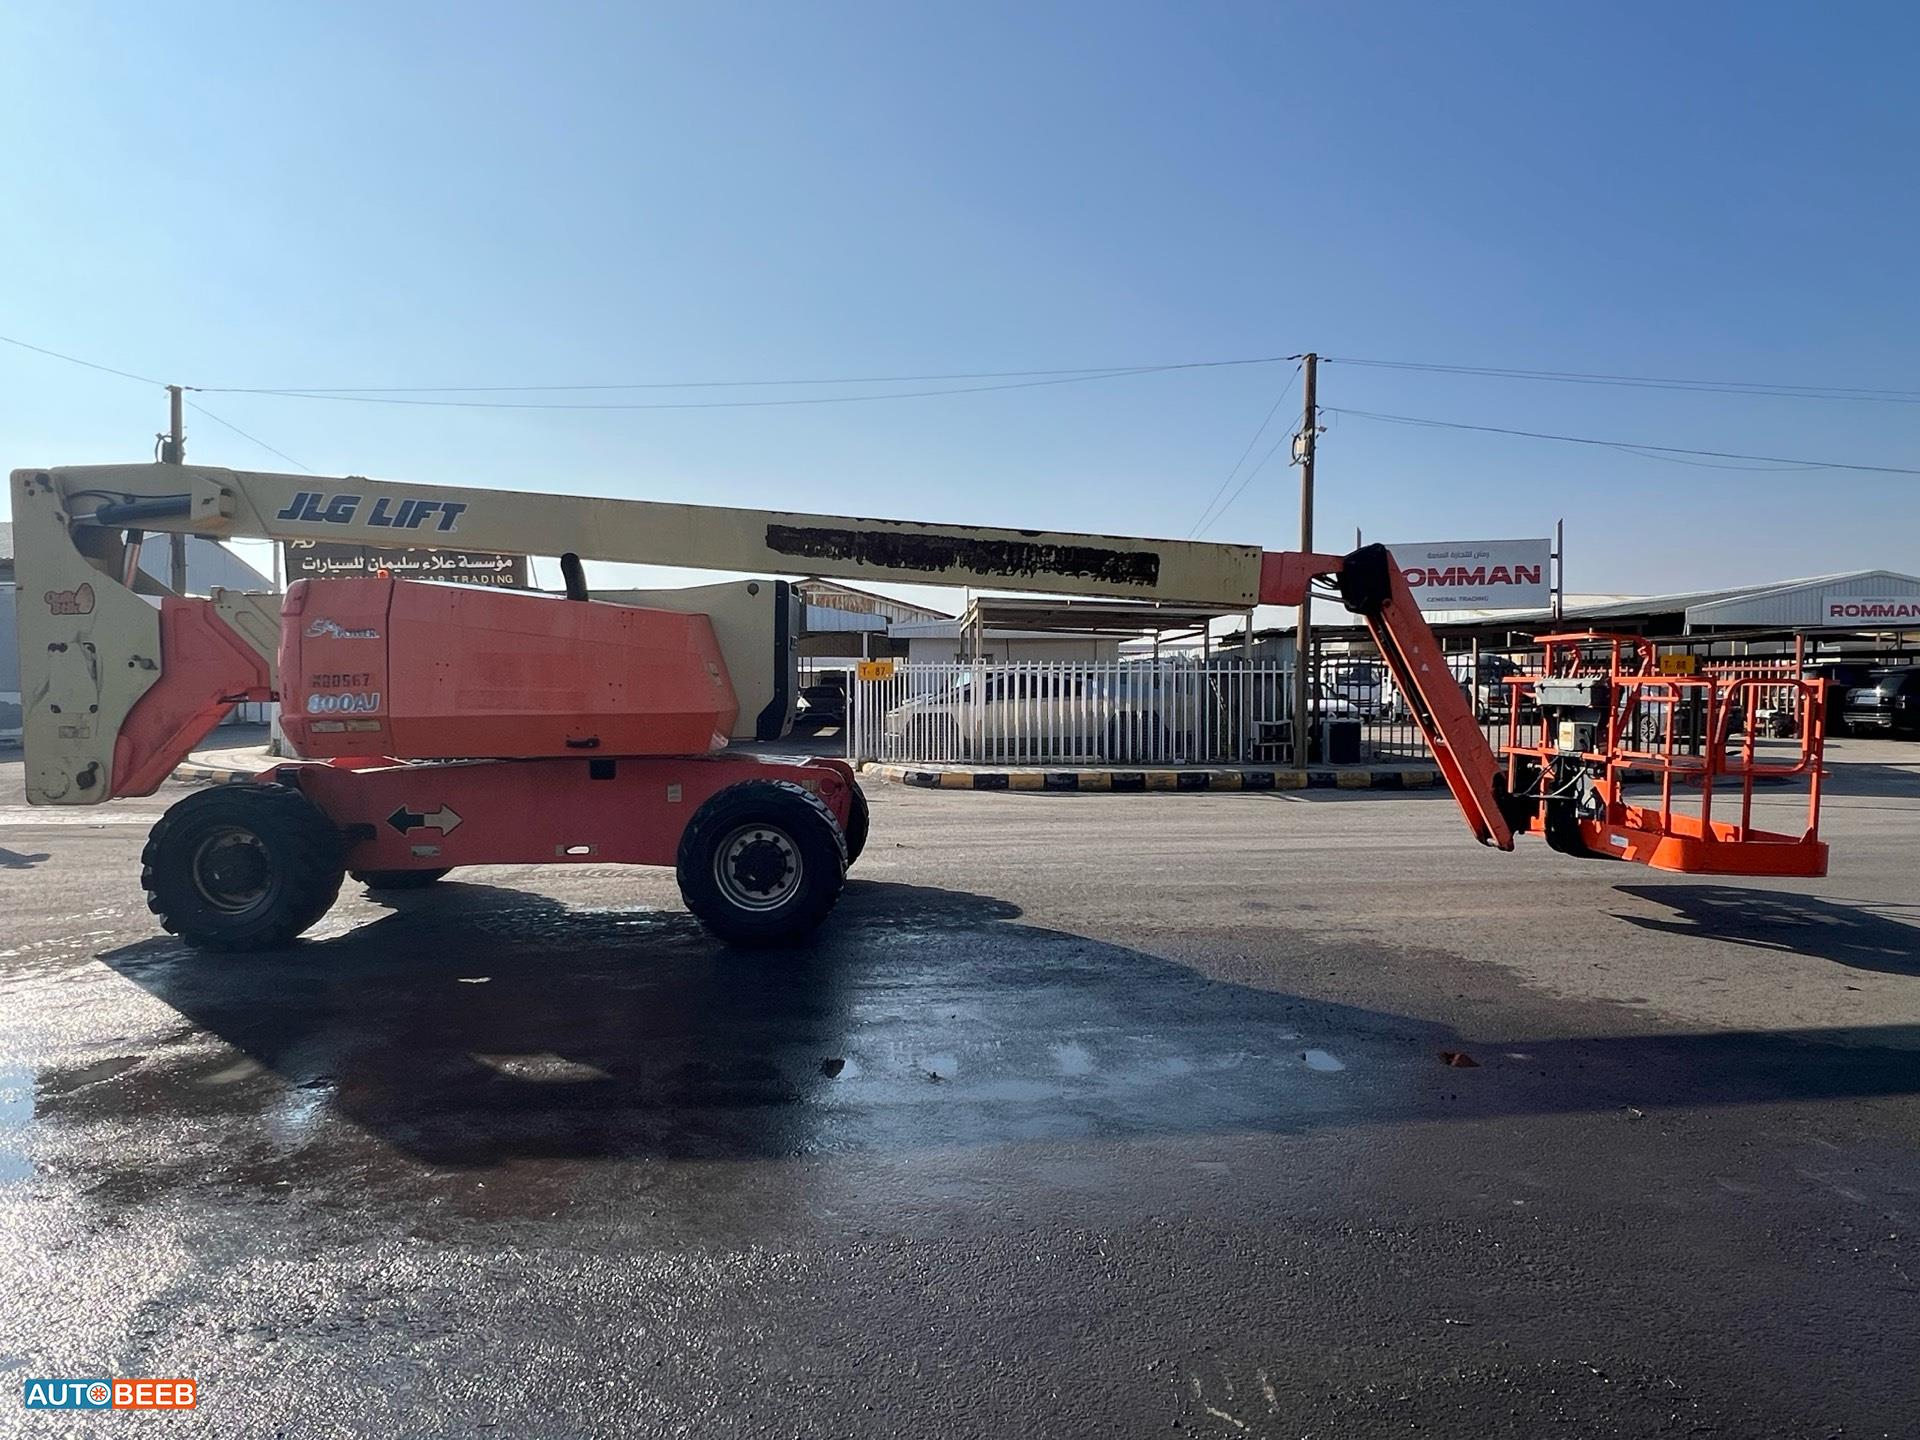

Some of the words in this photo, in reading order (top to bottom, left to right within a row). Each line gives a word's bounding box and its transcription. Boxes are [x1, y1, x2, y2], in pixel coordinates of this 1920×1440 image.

[276, 491, 362, 525] JLG
[367, 497, 469, 532] LIFT
[302, 556, 365, 574] للسيارات
[367, 556, 420, 573] سليمان
[422, 555, 457, 571] علاء
[458, 555, 513, 572] مؤسسة
[452, 575, 514, 584] TRADING
[1401, 564, 1541, 588] OMMAN
[307, 692, 381, 714] 800AJ
